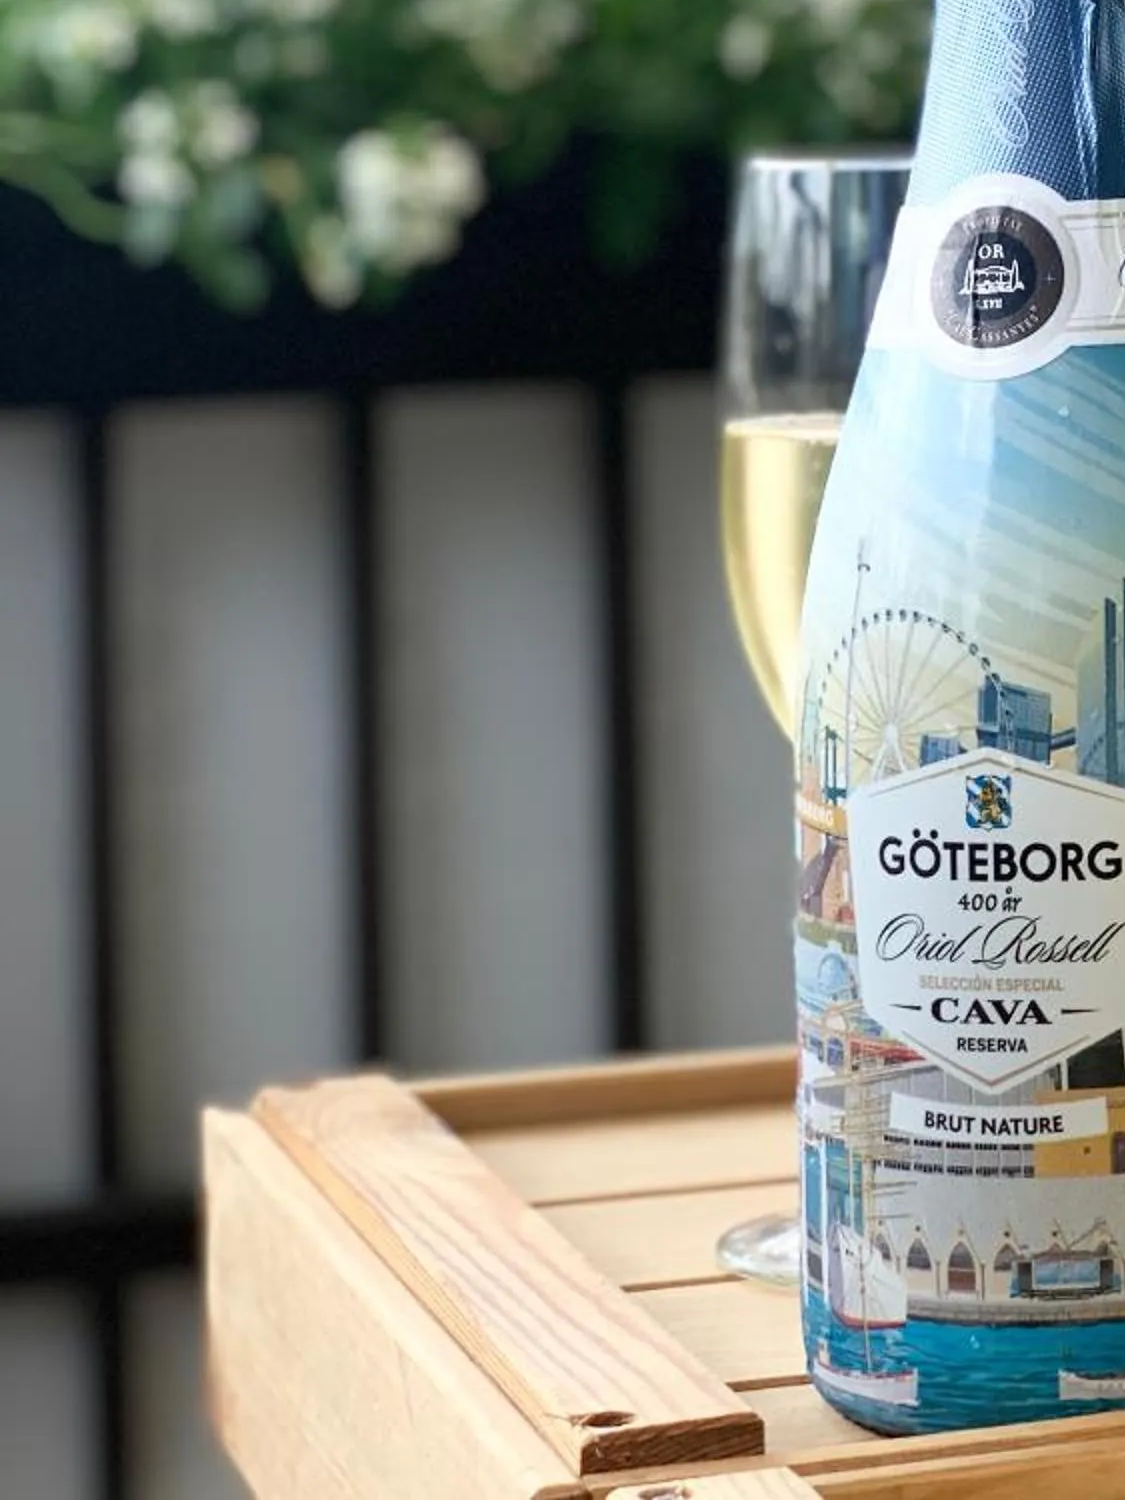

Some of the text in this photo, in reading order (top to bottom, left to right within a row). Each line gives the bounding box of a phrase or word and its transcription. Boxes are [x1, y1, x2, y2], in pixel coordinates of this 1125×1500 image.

[978, 243, 1005, 260] OR
[879, 828, 1123, 883] GÖTEBORG
[957, 886, 1023, 912] 400 år
[875, 913, 983, 963] Oriol
[918, 972, 1066, 992] SELECCIÓN ESPECIAL
[931, 997, 1052, 1025] CAVA
[956, 1037, 1029, 1053] RESERVA
[924, 1110, 1065, 1136] BRUT NATURE
